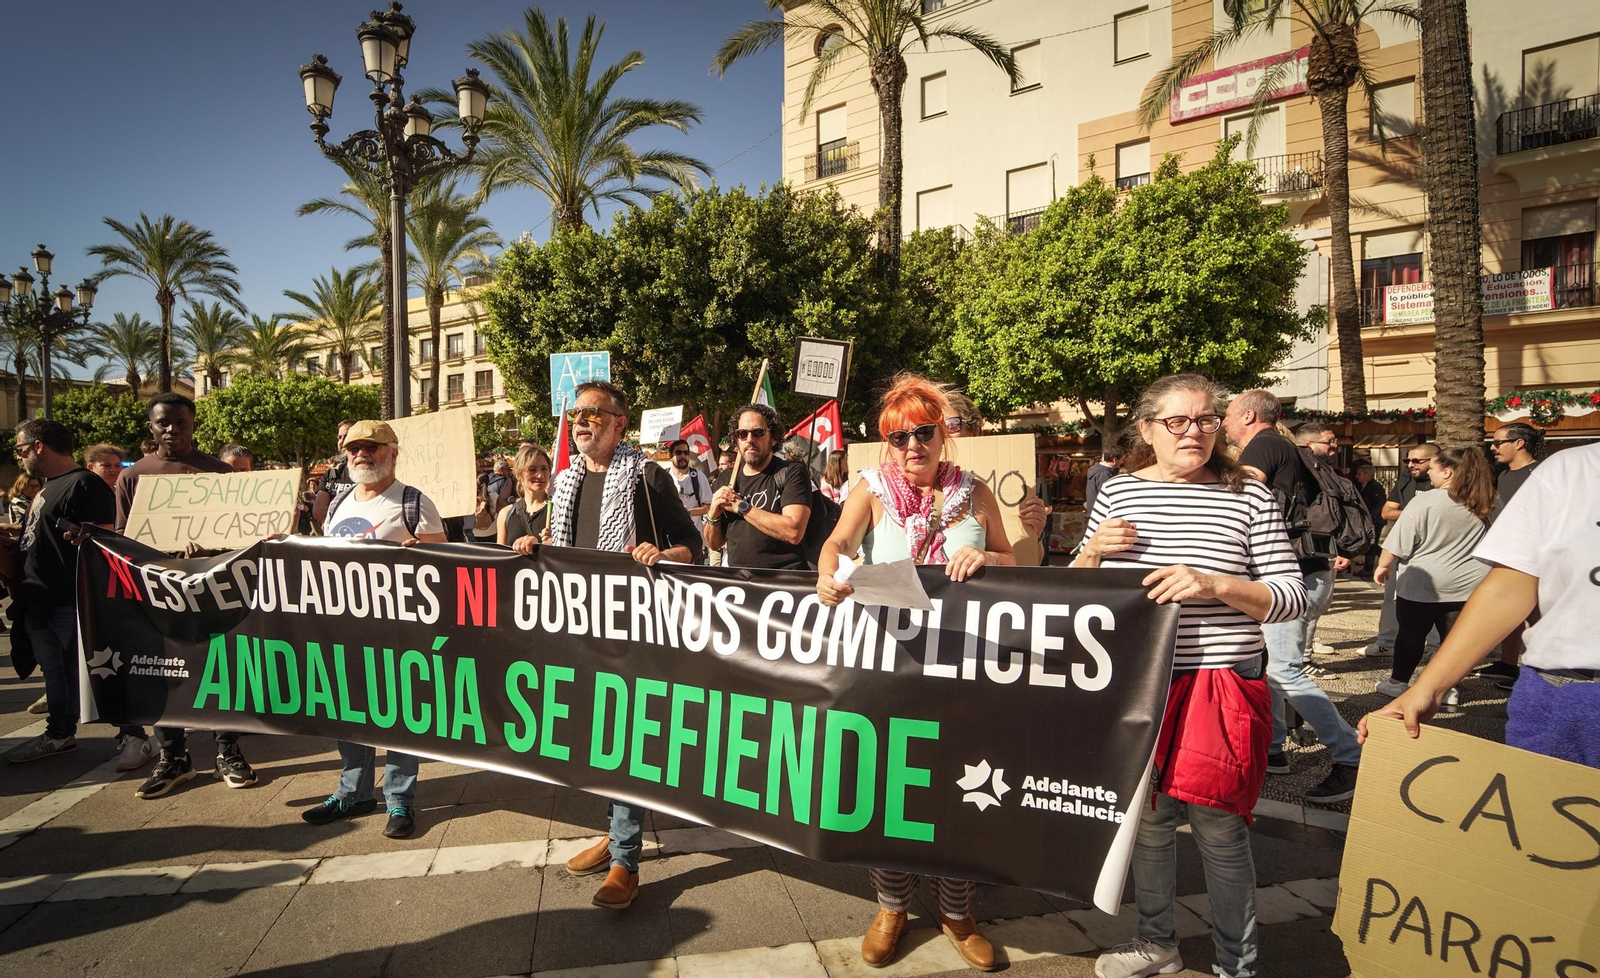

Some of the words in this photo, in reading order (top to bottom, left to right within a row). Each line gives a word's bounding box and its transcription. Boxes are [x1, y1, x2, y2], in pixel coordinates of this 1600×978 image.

[1387, 283, 1433, 294] DEFENDEMO
[1493, 273, 1503, 282] LO
[1505, 272, 1516, 281] DE
[1517, 268, 1549, 280] TODOS,
[1391, 301, 1432, 310] Sistema
[1401, 293, 1431, 302] públic
[1512, 296, 1550, 307] FRONTERA
[148, 476, 294, 511] DESAHUCIA
[134, 518, 157, 545] A
[172, 515, 206, 541] TU
[213, 510, 292, 539] CASERO
[141, 557, 441, 625] ESPECULADORES
[456, 566, 497, 628] NI
[513, 568, 746, 656] GOBIERNOS
[756, 590, 1116, 692] COMPLICES
[129, 665, 190, 678] Andalucía
[130, 654, 185, 667] Adelante
[193, 633, 487, 745] ANDALUCÍA
[503, 660, 575, 762] SE
[589, 671, 940, 843] DEFIENDE
[1021, 775, 1118, 804] Adelante
[1020, 793, 1127, 824] Andalucía
